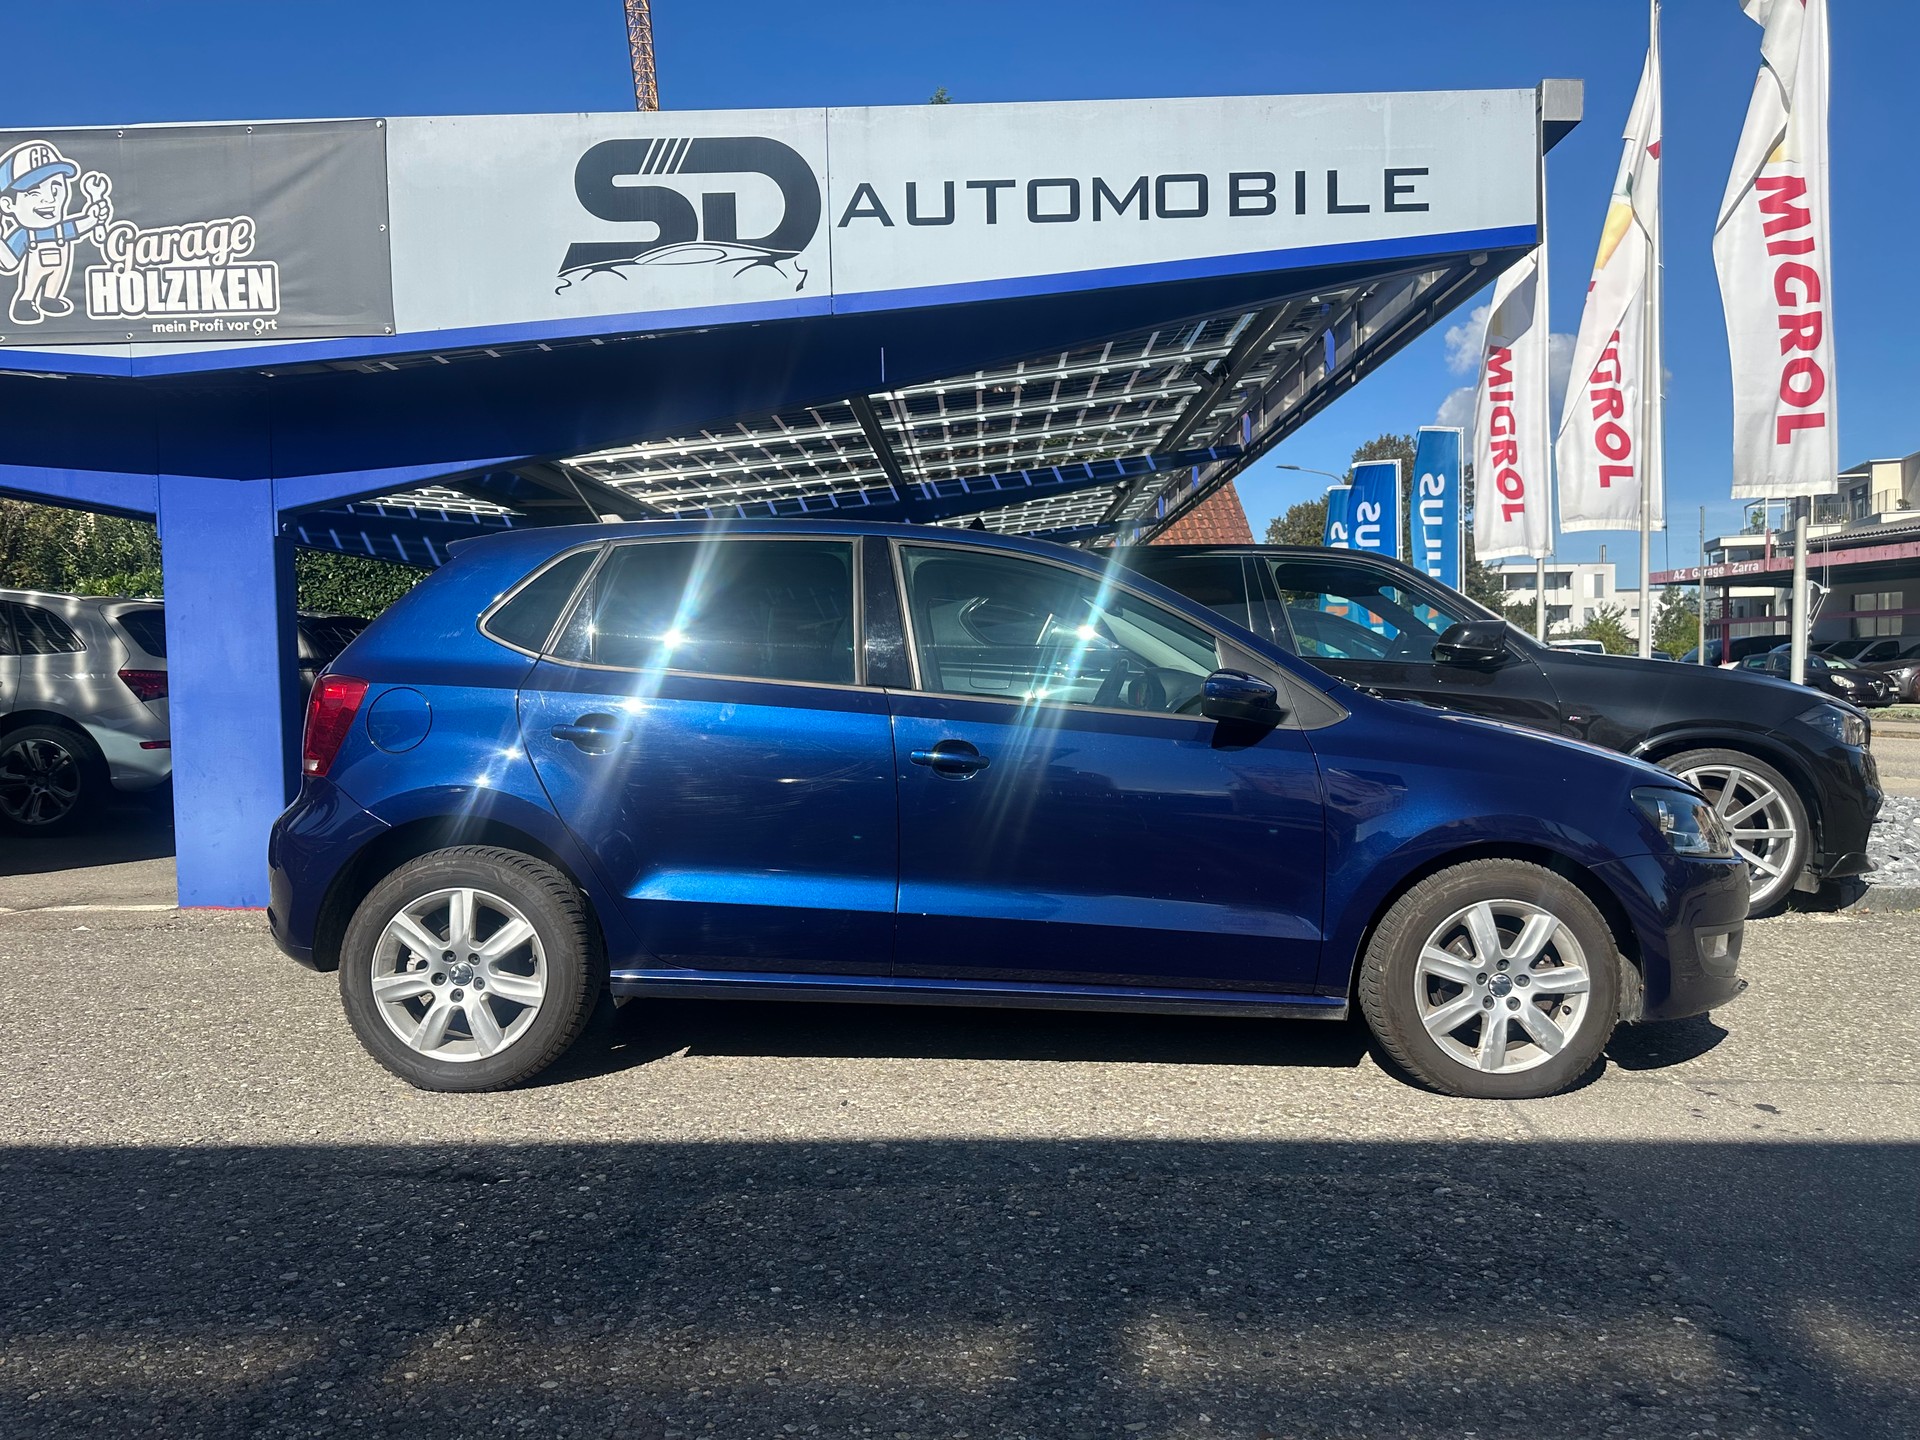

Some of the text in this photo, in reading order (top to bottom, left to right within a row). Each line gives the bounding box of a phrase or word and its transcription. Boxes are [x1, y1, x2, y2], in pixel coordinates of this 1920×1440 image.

[29, 147, 51, 170] GB
[557, 136, 1430, 277] SD AUTOMOBILE
[106, 222, 250, 277] Garage
[91, 267, 274, 314] HOLZIKEN
[1754, 175, 1826, 445] MIGROL
[152, 318, 277, 333] mein Profi vor Ort
[1487, 345, 1525, 522] MIGROL
[1588, 329, 1634, 488] GROL
[1673, 569, 1686, 580] AZ
[1731, 562, 1759, 574] Zarra
